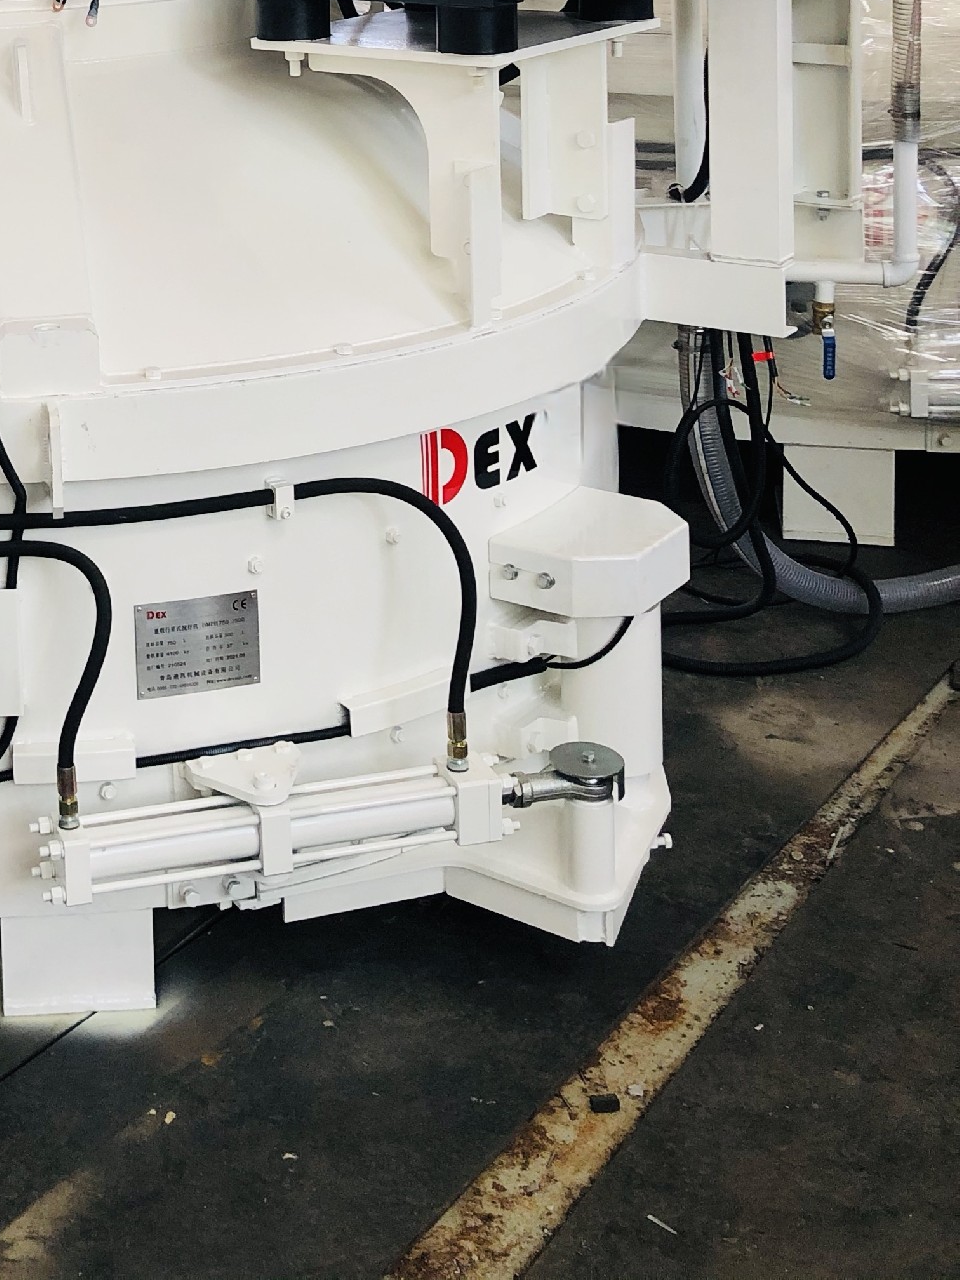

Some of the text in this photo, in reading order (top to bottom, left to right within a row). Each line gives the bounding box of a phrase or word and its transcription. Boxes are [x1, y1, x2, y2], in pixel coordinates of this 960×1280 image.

[420, 412, 538, 506] DEX
[232, 599, 247, 611] CE
[146, 611, 167, 619] DEX
